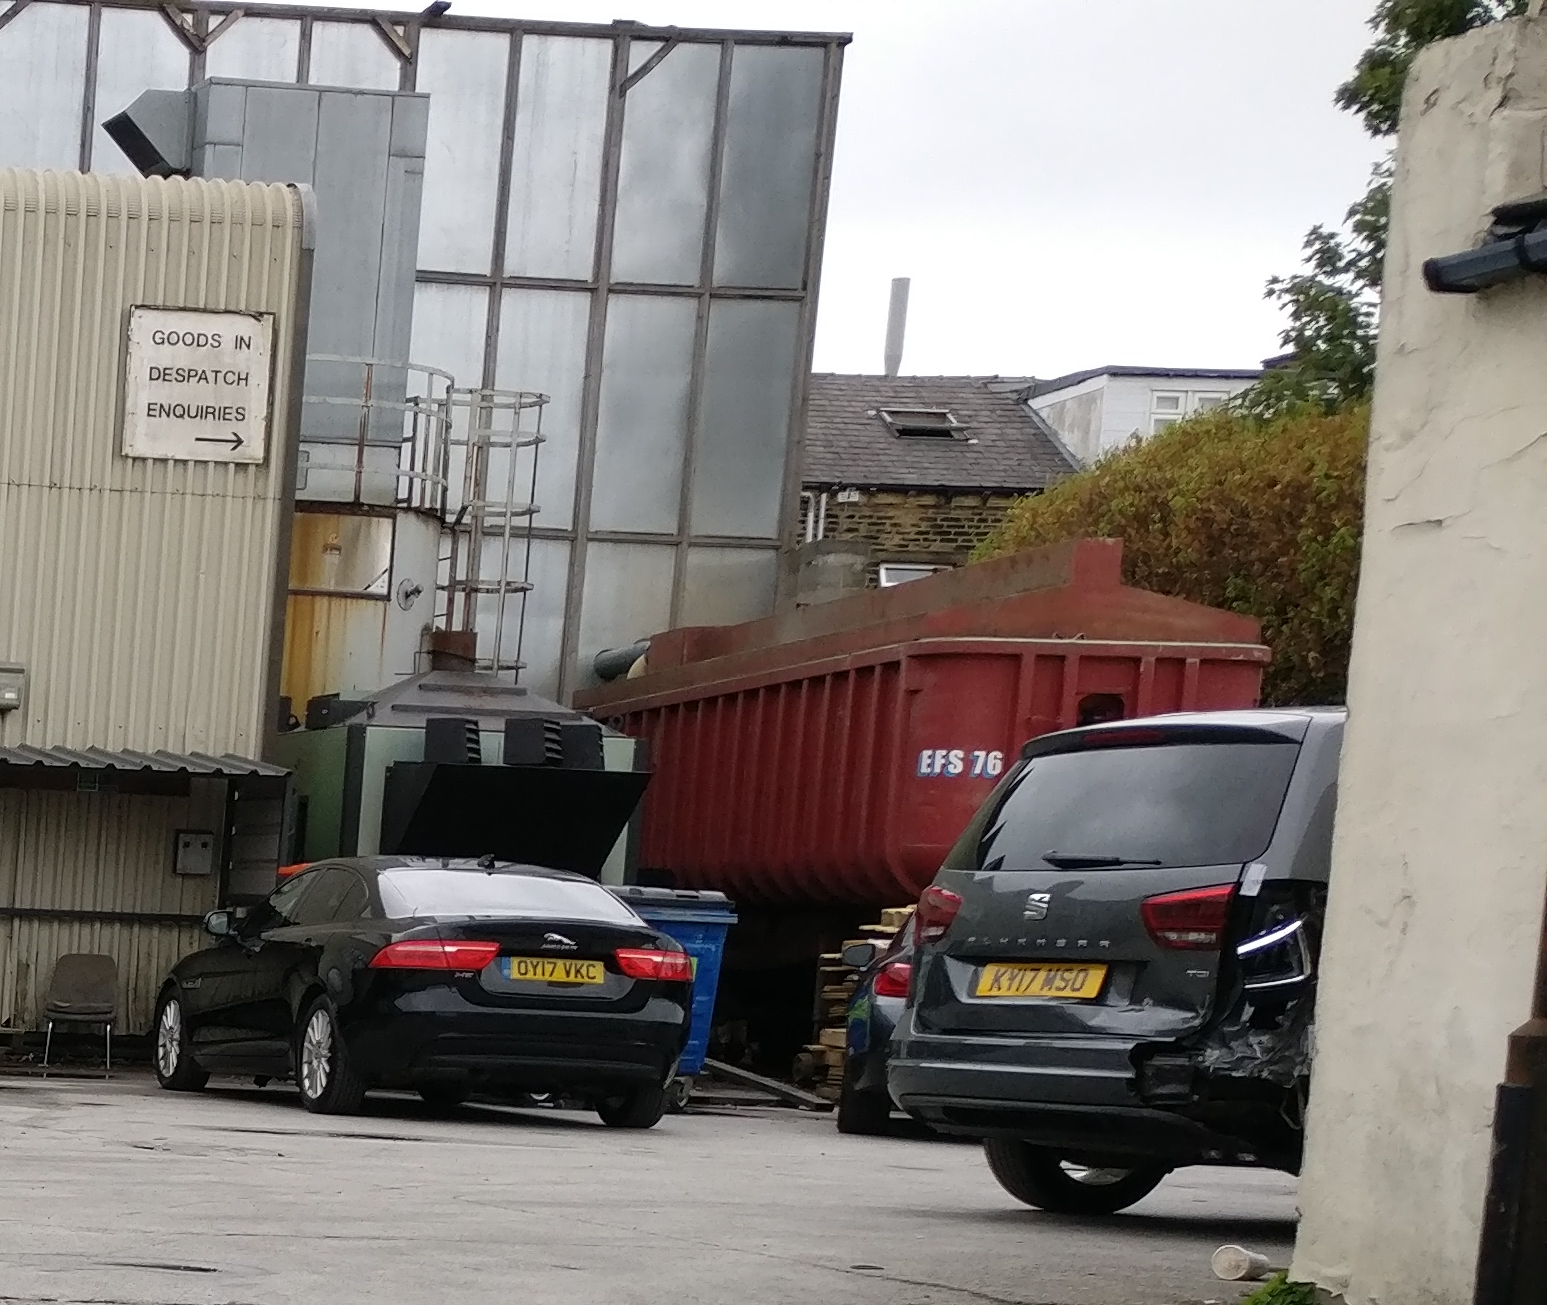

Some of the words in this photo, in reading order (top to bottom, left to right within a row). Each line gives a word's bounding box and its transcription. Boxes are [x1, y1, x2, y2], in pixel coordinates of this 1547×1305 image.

[151, 329, 222, 349] GOODS
[234, 333, 252, 351] IN
[148, 366, 250, 387] DESPATCH
[146, 402, 246, 421] ENQUIRIES
[917, 749, 965, 777] EFS
[972, 749, 1004, 779] 76
[517, 959, 557, 978] OY17
[563, 961, 597, 980] VKC
[988, 967, 1042, 993] KY17
